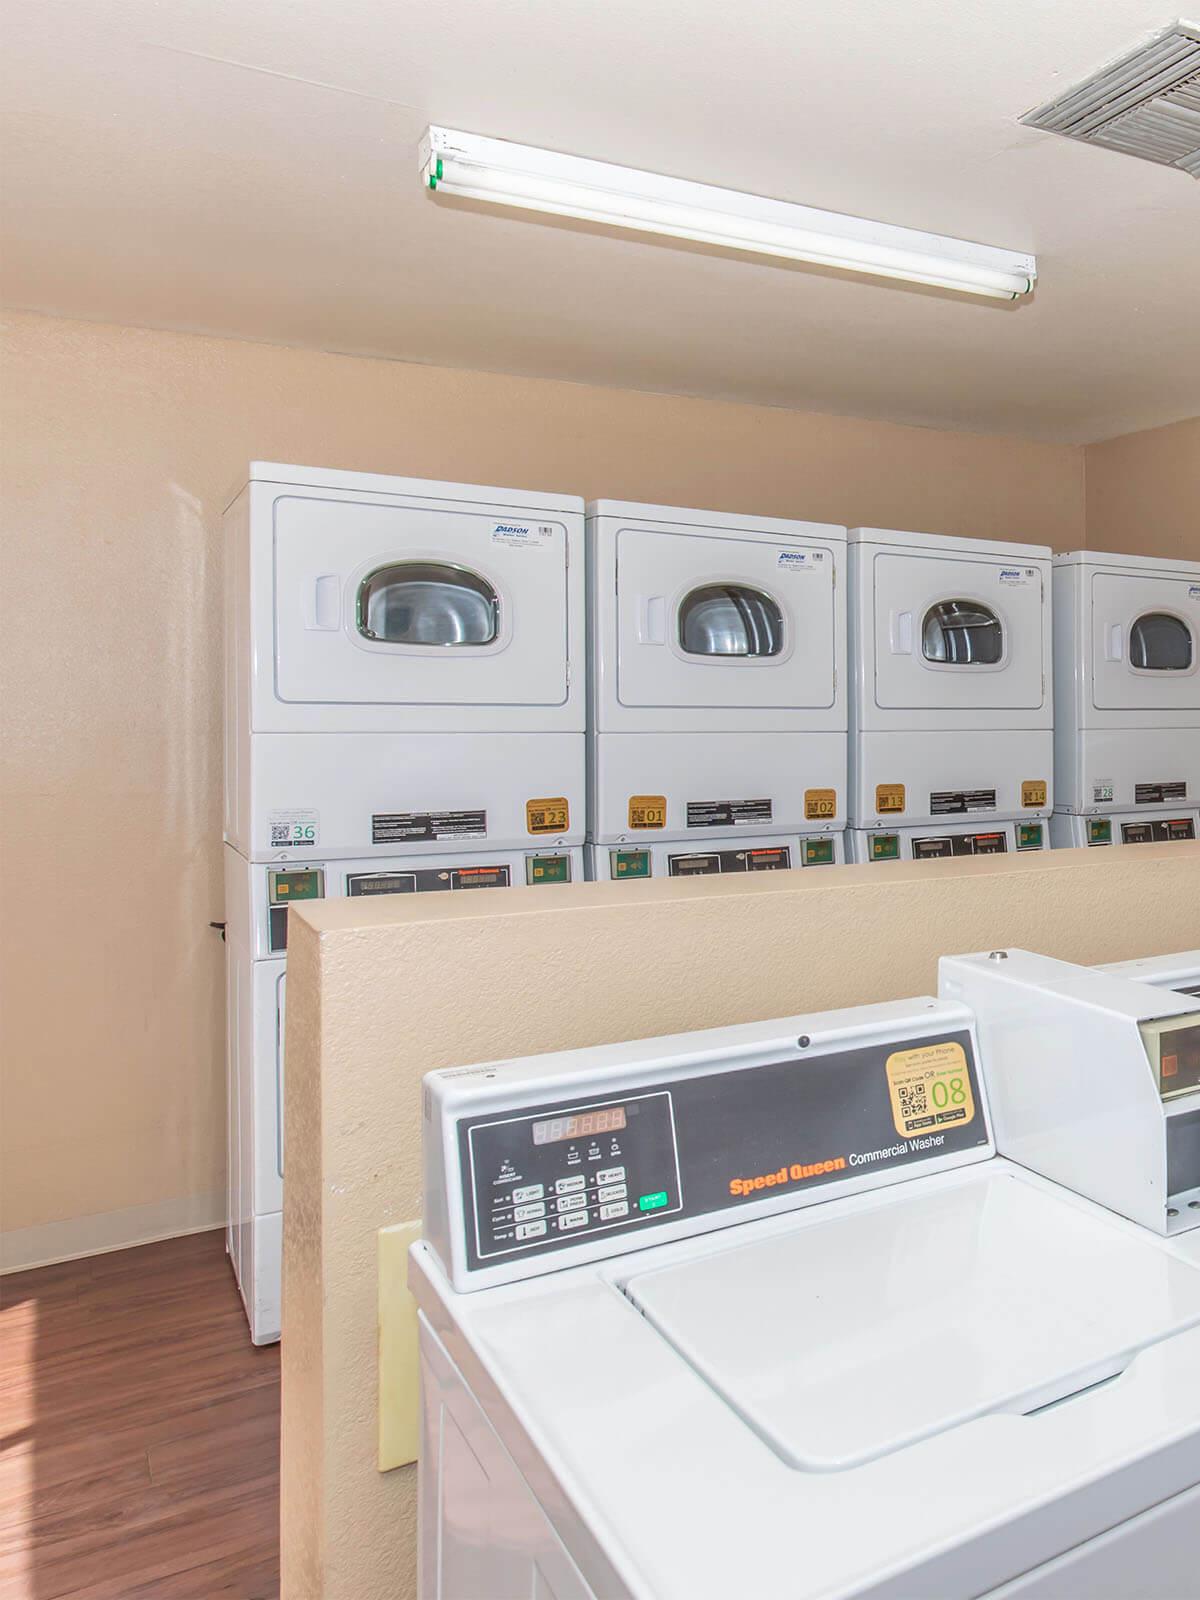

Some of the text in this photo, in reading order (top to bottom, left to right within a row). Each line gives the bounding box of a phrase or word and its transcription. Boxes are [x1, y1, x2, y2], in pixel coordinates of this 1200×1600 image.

[495, 525, 529, 535] DADSON
[1103, 788, 1113, 797] 28
[819, 803, 833, 813] 02
[547, 811, 566, 824] 23
[647, 810, 662, 822] 01
[293, 825, 315, 839] 36
[924, 1070, 935, 1079] OR
[932, 1078, 966, 1108] 08
[729, 1133, 945, 1196] Speed Queen Commercial Washer
